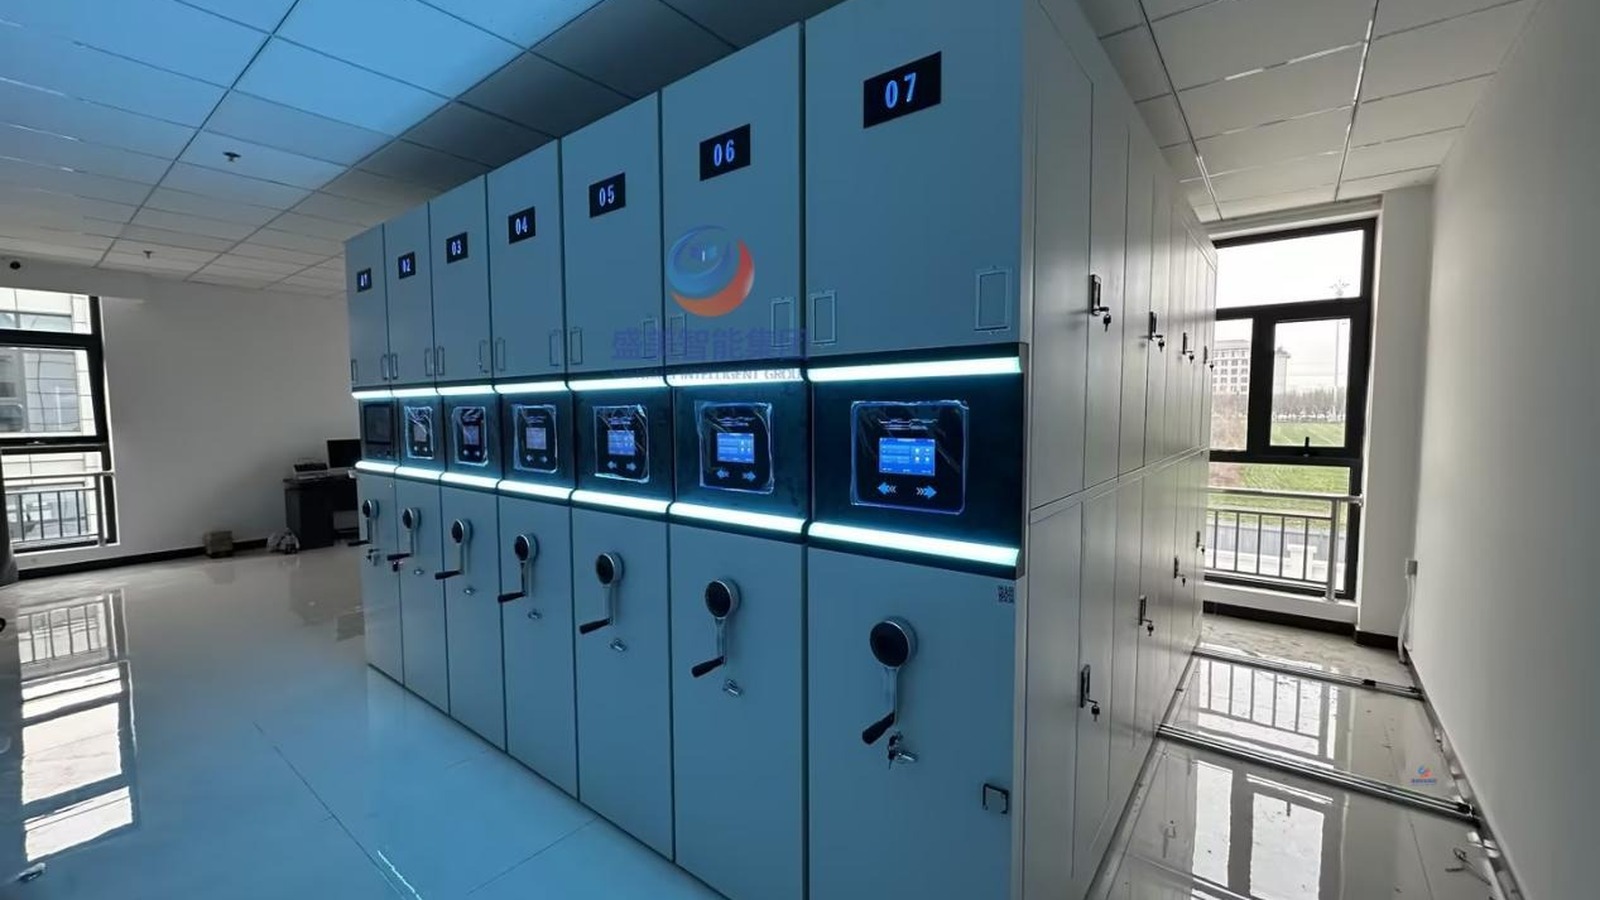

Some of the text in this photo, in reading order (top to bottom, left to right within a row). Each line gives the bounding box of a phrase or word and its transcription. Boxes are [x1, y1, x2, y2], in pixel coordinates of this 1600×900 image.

[885, 72, 918, 109] 07
[713, 139, 736, 167] 06
[599, 184, 616, 207] 05
[515, 216, 528, 235] 04
[451, 240, 462, 256] 03
